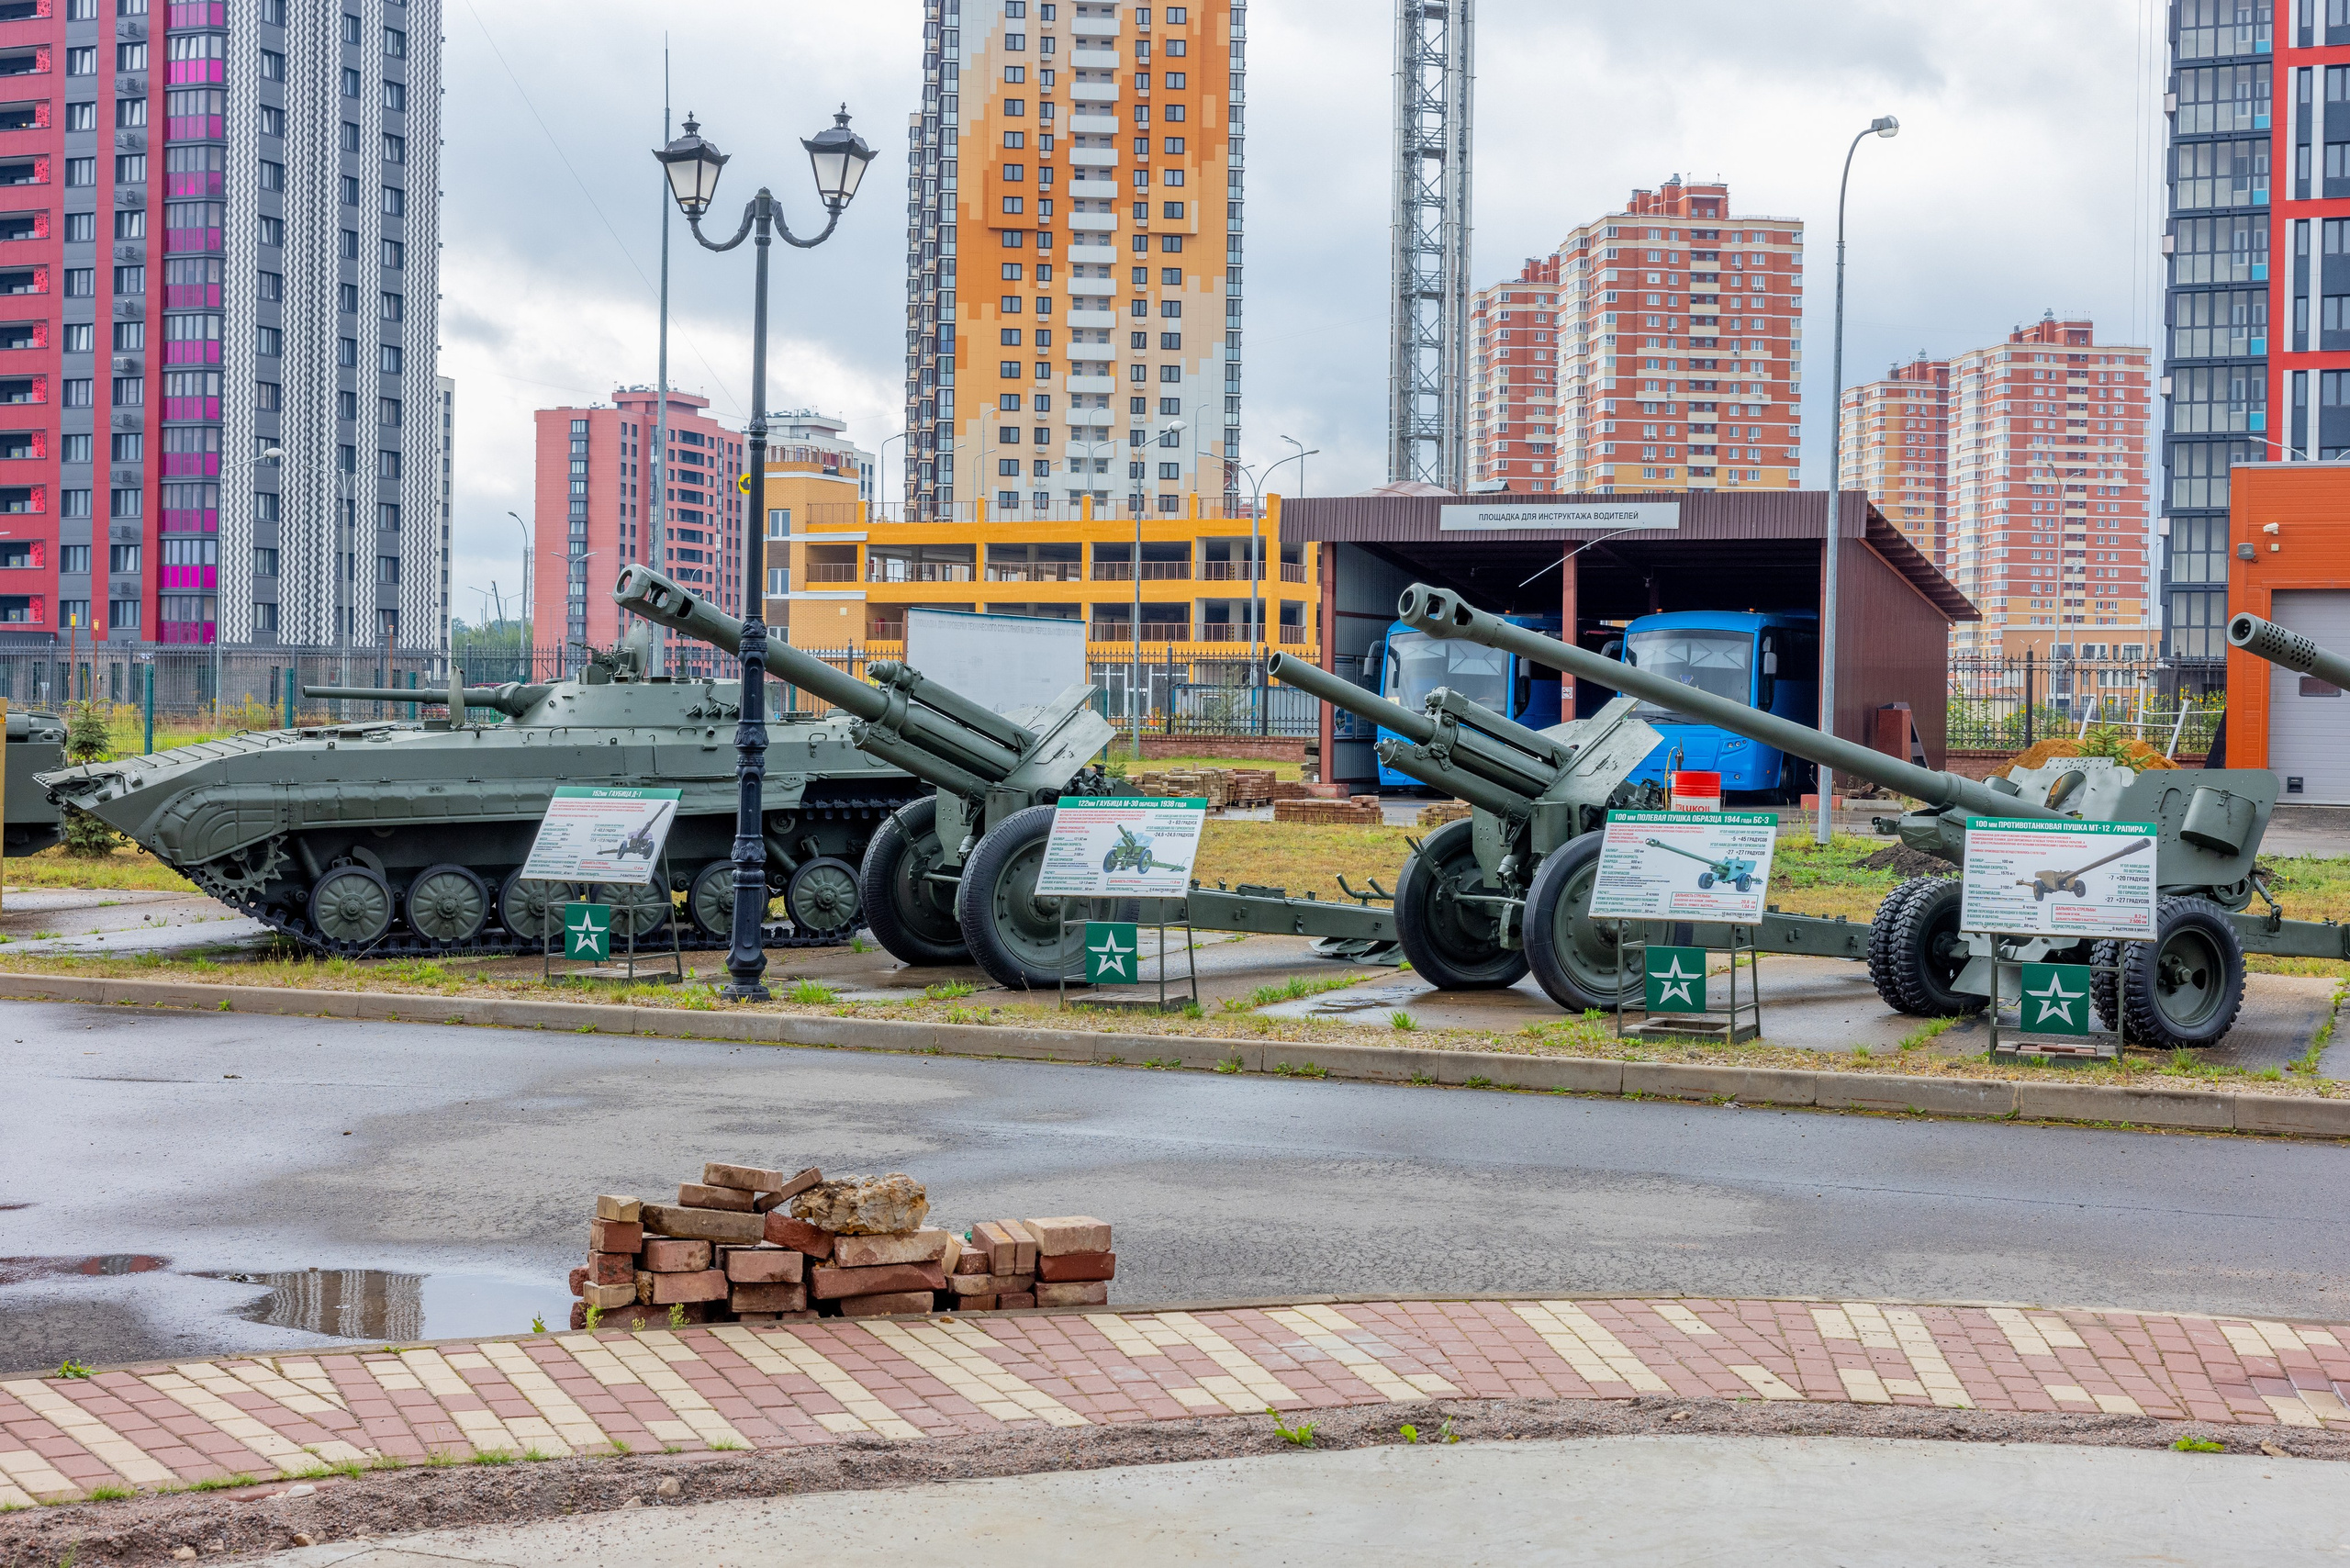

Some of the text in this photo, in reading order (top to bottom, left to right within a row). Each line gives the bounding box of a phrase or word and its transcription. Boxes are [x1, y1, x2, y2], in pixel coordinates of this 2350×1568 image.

[1479, 513, 1520, 521] ПЛОЩАДКА
[1521, 513, 1537, 521] ДЛЯ
[1594, 511, 1639, 521] ВОДИТЕЛЕЙ
[968, 622, 997, 632] ТЕХНИЧЕСКОГО
[998, 624, 1020, 633] СОСТОЯНИЯ
[1692, 815, 1722, 823] ОБРАЗЦА
[1998, 822, 2062, 830] ПРОТИВОТАНКОВАЯ
